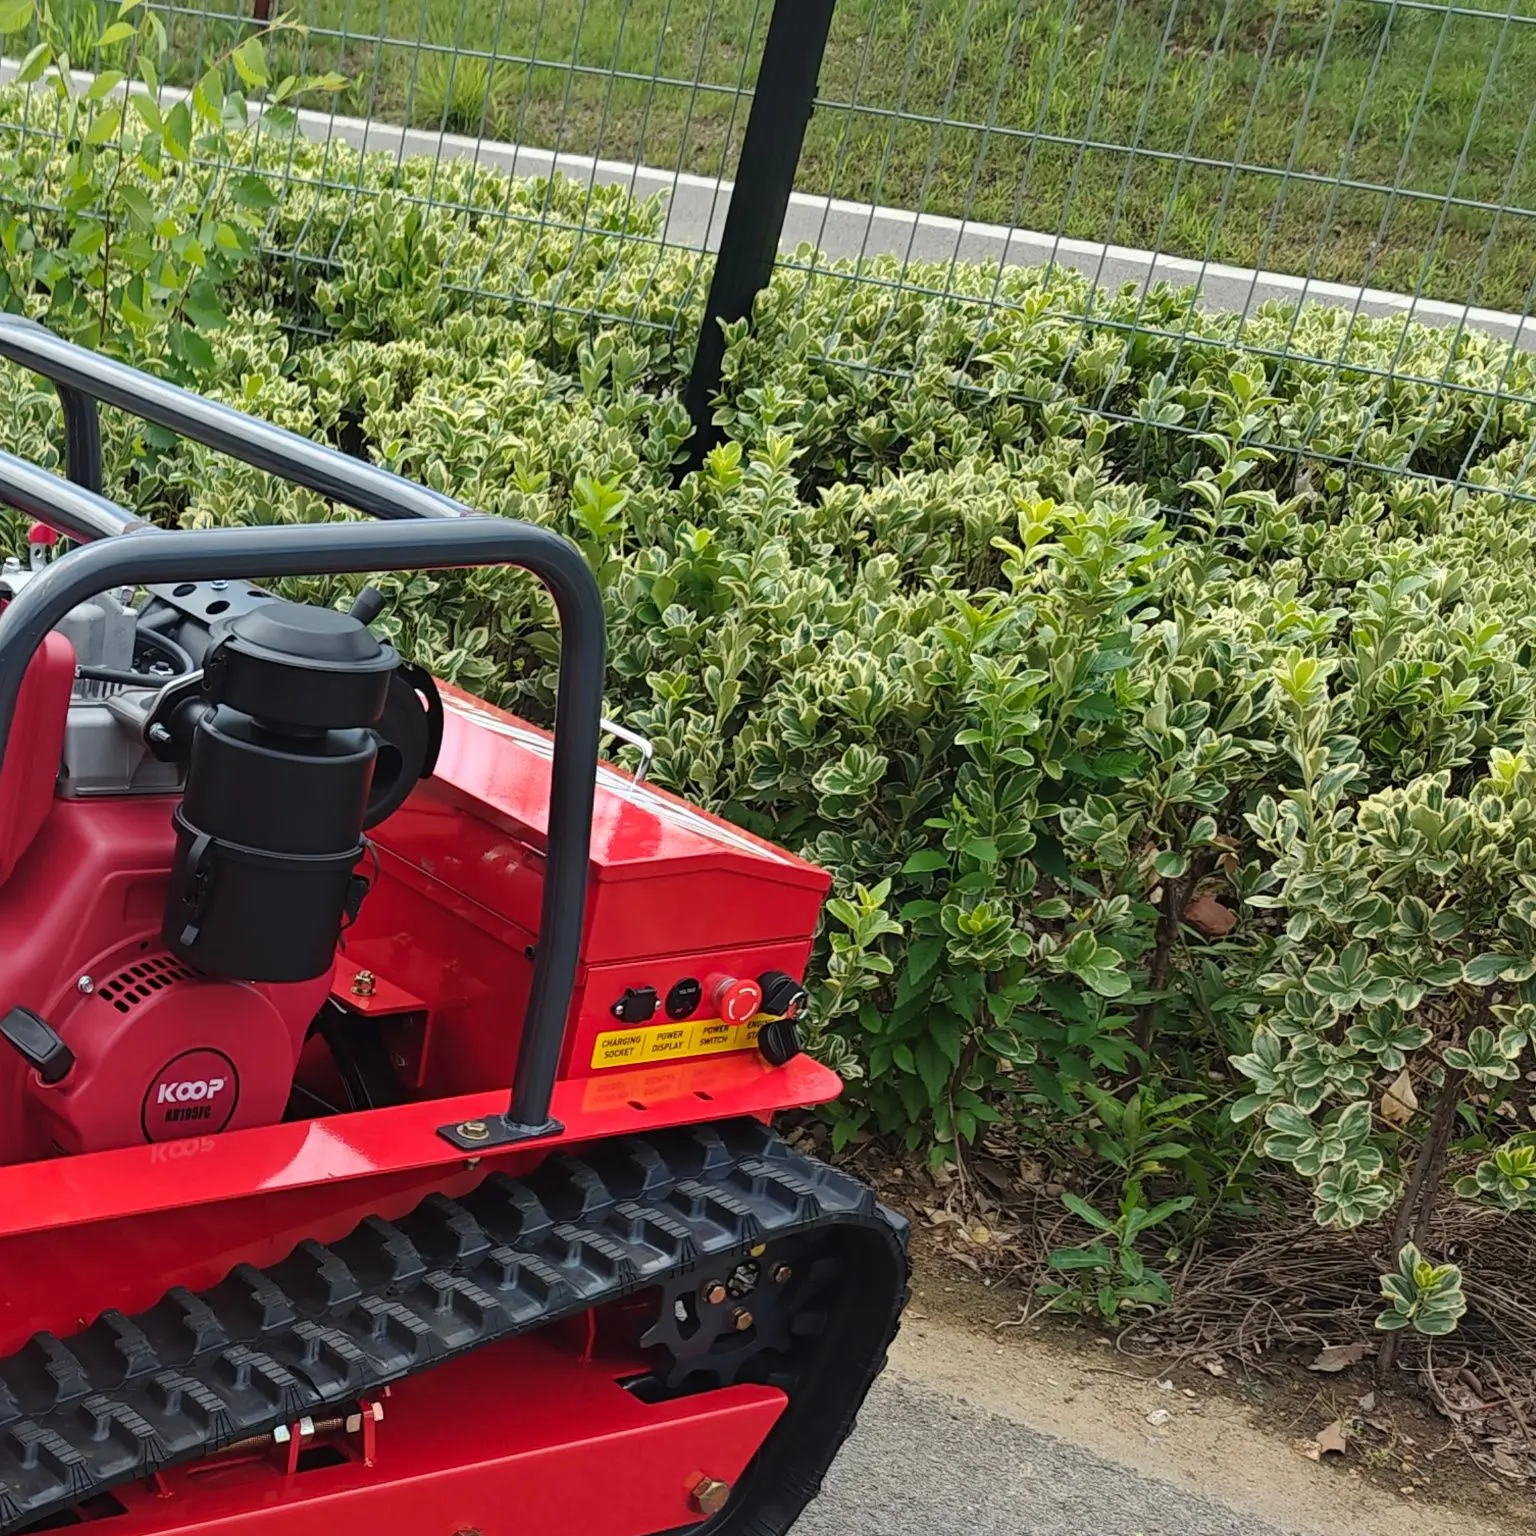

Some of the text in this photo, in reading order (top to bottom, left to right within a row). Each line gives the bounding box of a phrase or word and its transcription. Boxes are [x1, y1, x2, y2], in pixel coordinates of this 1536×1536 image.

[656, 1030, 683, 1041] POWER
[702, 1024, 729, 1035] POWER
[601, 1035, 641, 1048] CHARGING
[699, 1035, 728, 1046] SWITCH
[603, 1047, 634, 1059] SOCKET
[651, 1041, 683, 1053] DISPLAY
[157, 1078, 225, 1104] KOOP
